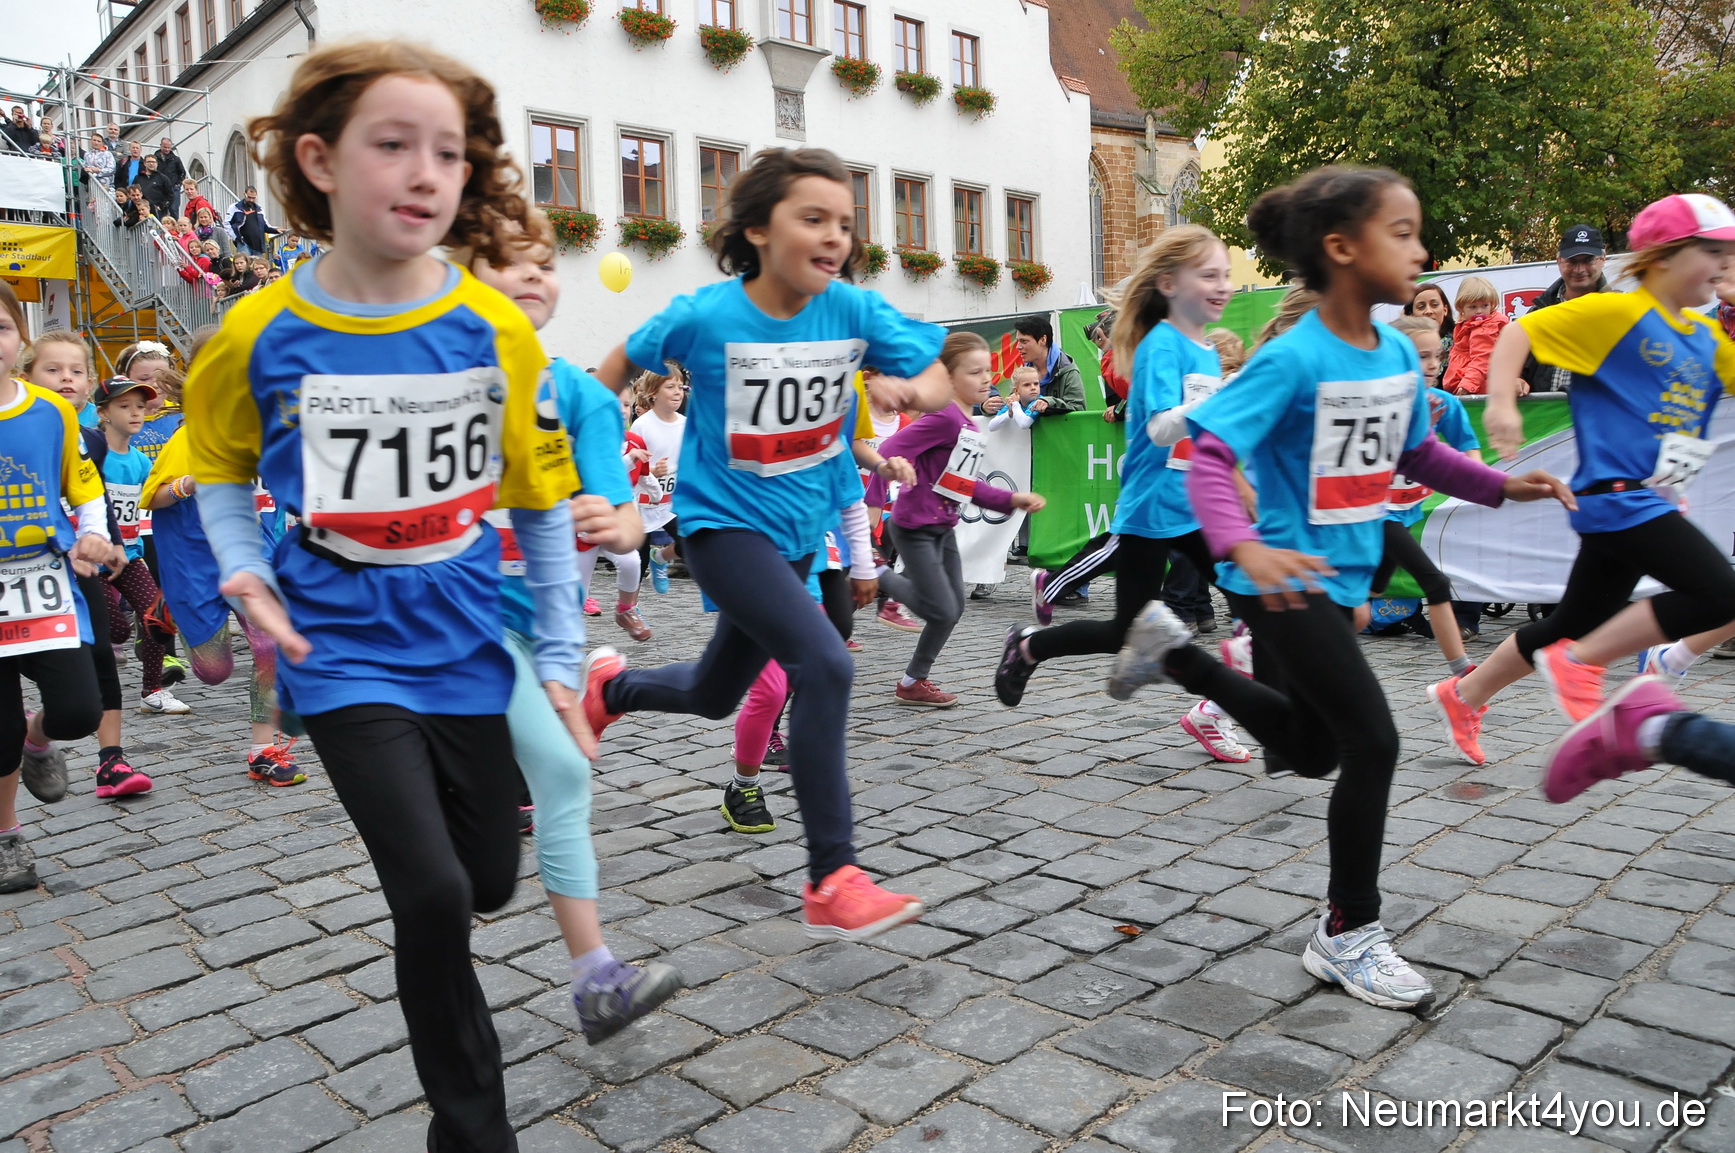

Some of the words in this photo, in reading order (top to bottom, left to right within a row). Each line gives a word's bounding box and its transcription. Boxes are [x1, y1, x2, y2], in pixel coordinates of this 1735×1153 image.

[12, 252, 52, 261] Stadtlauf
[307, 397, 384, 415] PARTL
[389, 391, 482, 415] Neumarkt
[744, 371, 848, 426] 7031
[329, 412, 489, 501] 7156
